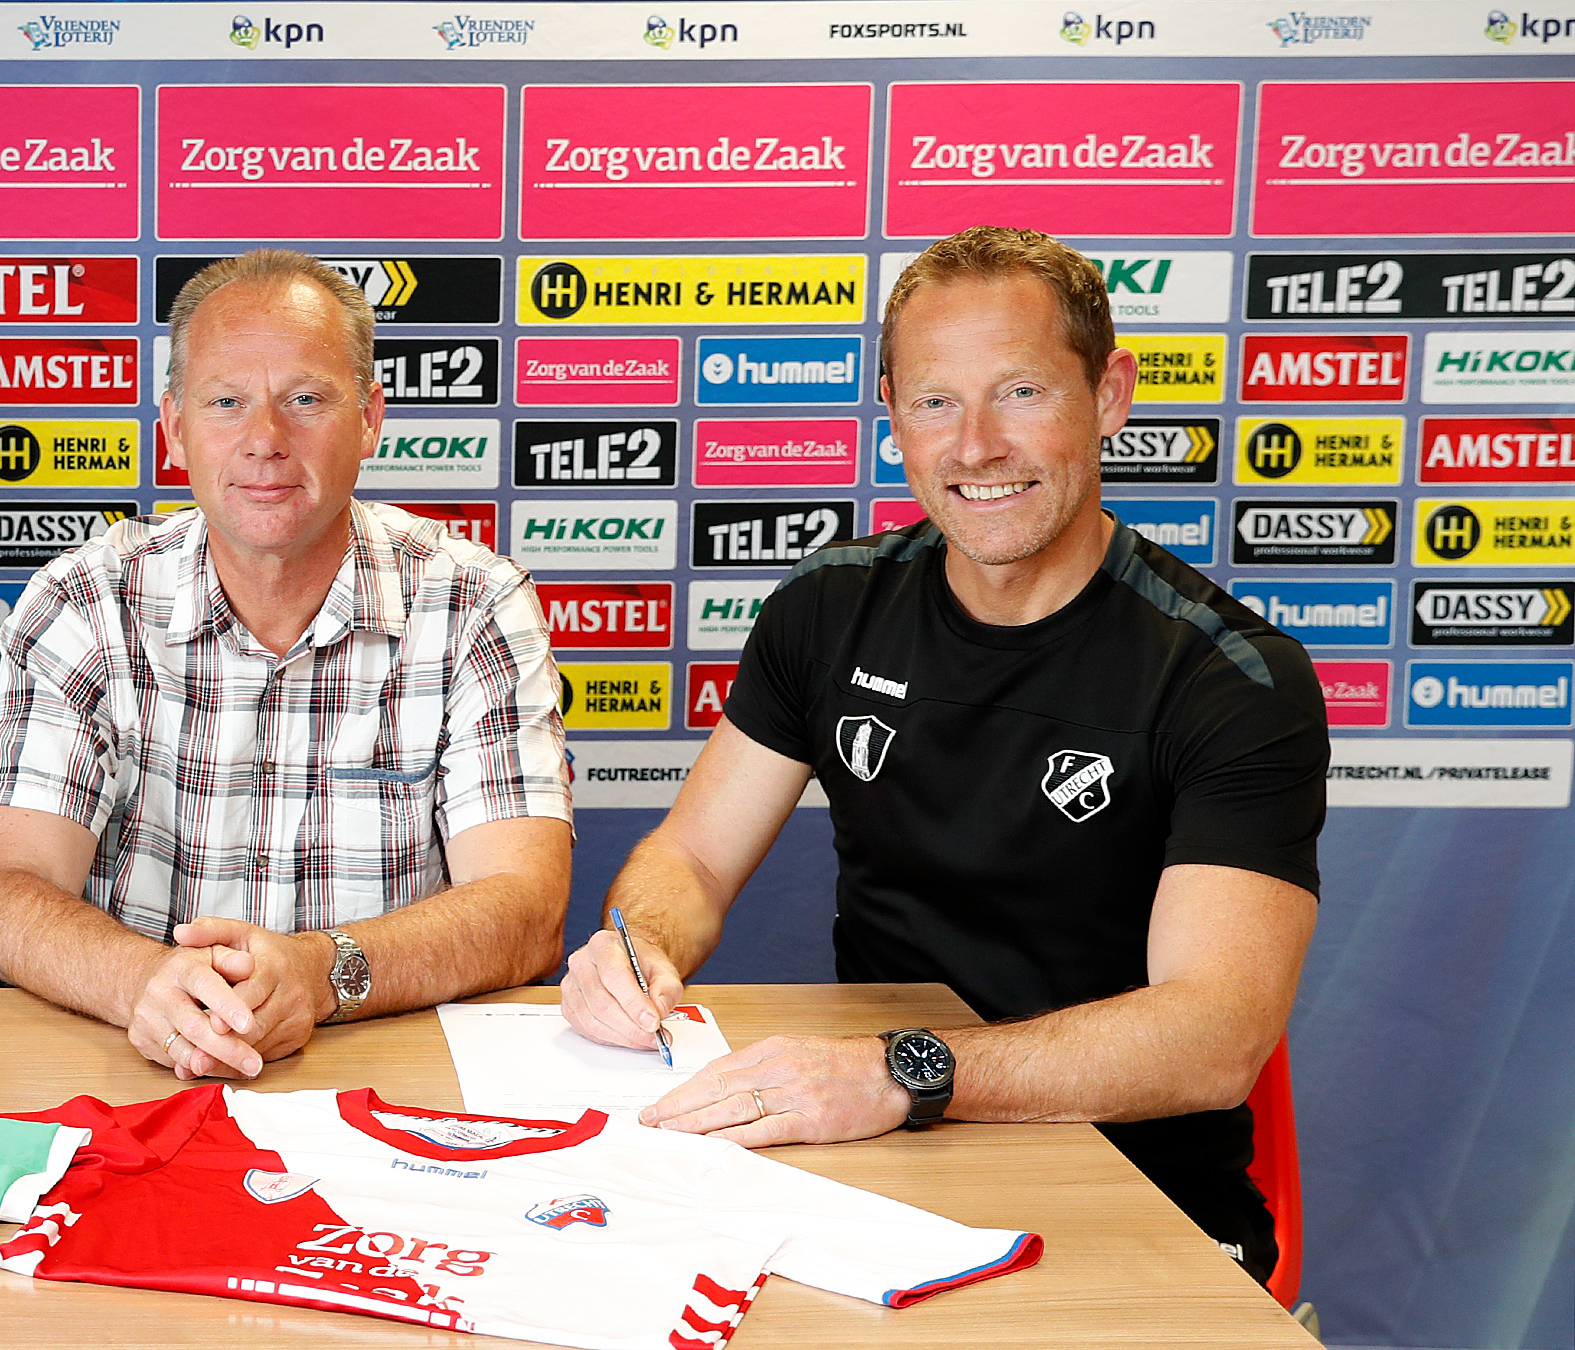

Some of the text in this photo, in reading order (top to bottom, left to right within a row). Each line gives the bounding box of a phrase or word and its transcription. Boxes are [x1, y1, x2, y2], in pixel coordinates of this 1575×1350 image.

[39, 15, 120, 34] VRIENDEN
[452, 15, 535, 32] VRIENDEN
[830, 23, 967, 38] FOXSPORTS.NL
[1096, 14, 1155, 45] kpn
[1289, 11, 1371, 29] VRIENDEN
[54, 31, 113, 47] LOTERIJ
[265, 17, 324, 49] kpn
[468, 29, 527, 47] LOTERIJ
[679, 17, 738, 49] kpn
[1303, 25, 1366, 43] LOTERIJ
[24, 138, 116, 172] Zaak
[181, 137, 481, 180] Zorg van de Zaak
[545, 136, 846, 181] Zorg van de Zaak
[910, 134, 1214, 178] Zorg van de Zaak
[1279, 135, 1367, 177] Zorg
[1369, 142, 1441, 168] van
[1444, 133, 1491, 167] de
[594, 281, 855, 306] HENRI & HERMAN
[1266, 260, 1404, 314] TELE2
[1442, 259, 1575, 313] TELE2
[1118, 304, 1159, 316] TOOLS
[526, 359, 669, 381] Zorg van de Zaak
[737, 352, 855, 384] hummel
[1138, 353, 1192, 369] HENRI
[1247, 352, 1402, 386] AMSTEL
[373, 349, 483, 399] ELE2
[1138, 369, 1215, 384] HERMAN
[53, 437, 106, 452] HENRI
[377, 436, 487, 459] iKOKI
[529, 428, 662, 480] TELE2
[704, 440, 848, 462] Zorg van de Zaak
[1100, 430, 1179, 459] ASSY
[1316, 435, 1368, 450] HENRI
[1426, 434, 1575, 469] AMSTEL
[54, 455, 131, 470] HERMAN
[362, 464, 482, 472] PERFORMANCE POWER TOOLS
[1315, 452, 1392, 468] HERMAN
[523, 518, 665, 540] HiKOKI
[709, 509, 839, 560] TELE2
[1253, 514, 1355, 539] DASSY
[1495, 516, 1549, 532] HENRI
[543, 545, 659, 553] PERFORMANCE POWER TOOLS
[1494, 534, 1571, 549] HERMAN
[549, 600, 666, 633] MSTEL
[1268, 596, 1387, 628] hummel
[1432, 595, 1534, 620] DASSY
[586, 680, 638, 695] HENRI
[850, 666, 909, 700] hummel
[1447, 676, 1568, 709] hummel
[586, 697, 661, 713] HERMAN
[1060, 756, 1076, 773] F
[1428, 767, 1549, 780] /PRIVATELEASE
[1051, 760, 1106, 805] UTRECHT
[1079, 792, 1095, 809] C
[391, 1158, 488, 1179] hummel
[296, 1223, 498, 1276] Zorg
[288, 1254, 419, 1277] van de
